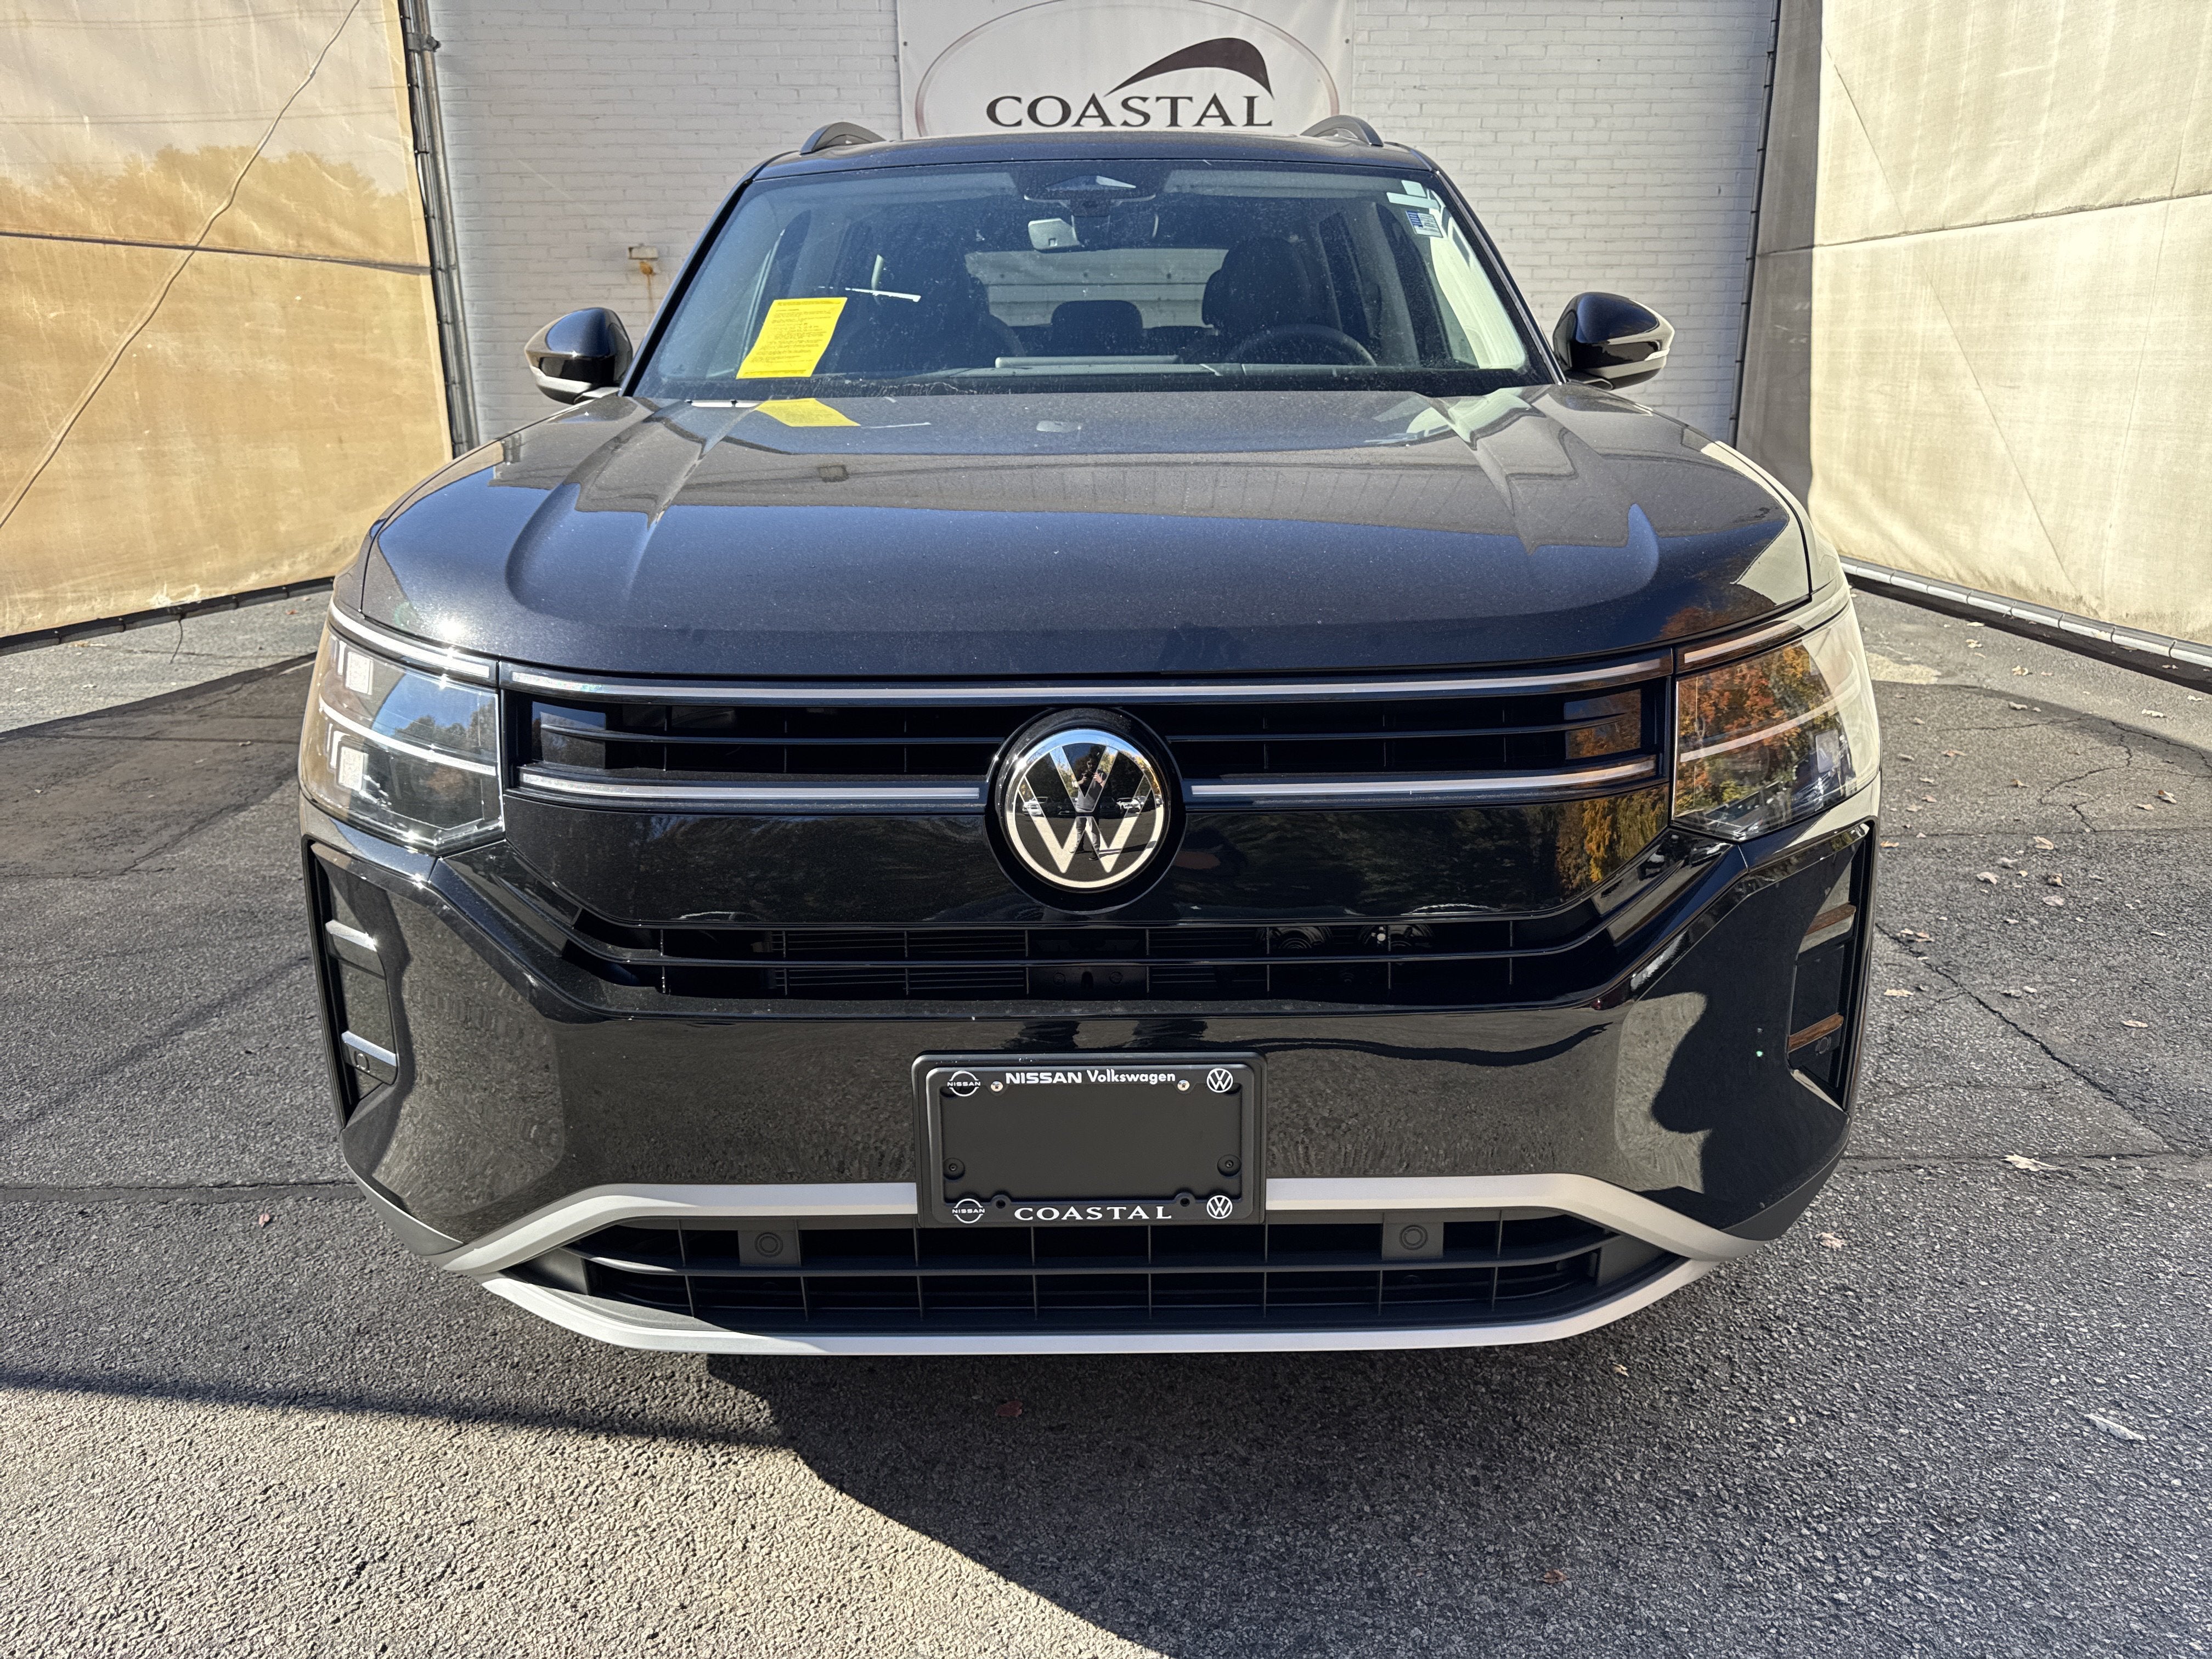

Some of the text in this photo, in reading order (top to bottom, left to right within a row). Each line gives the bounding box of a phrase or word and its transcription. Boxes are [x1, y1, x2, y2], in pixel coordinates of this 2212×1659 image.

[986, 92, 1273, 128] COASTAL
[1005, 1068, 1176, 1085] NISSAN Volkswagen
[1014, 1205, 1172, 1221] COASTAL
